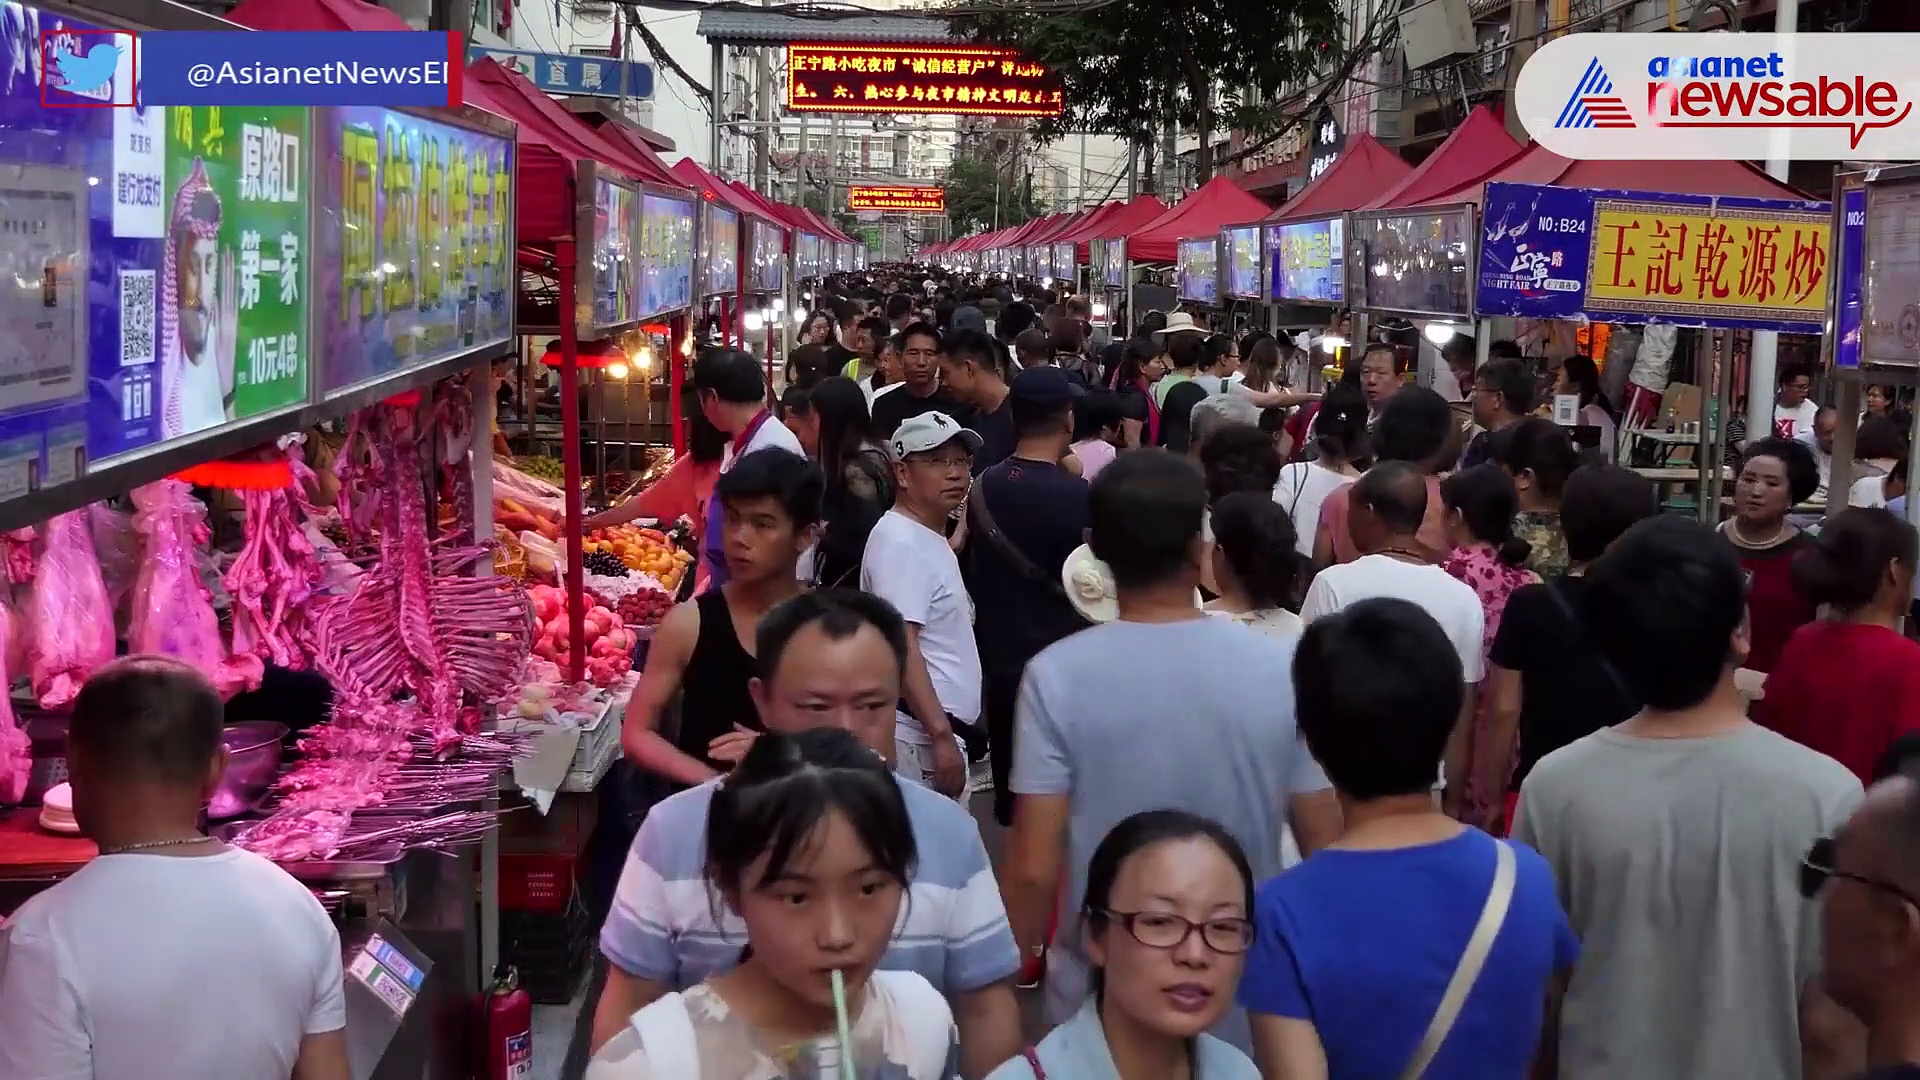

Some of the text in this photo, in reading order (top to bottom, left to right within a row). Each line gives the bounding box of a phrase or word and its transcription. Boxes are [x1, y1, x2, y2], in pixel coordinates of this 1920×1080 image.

[241, 123, 299, 202] 原路口
[1538, 216, 1585, 233] NO:B24
[240, 230, 298, 310] 第一家
[1510, 280, 1530, 290] FAIR
[1596, 219, 1827, 305] 王記乾源炒
[248, 331, 298, 385] 10元4串
[895, 440, 904, 457] 3
